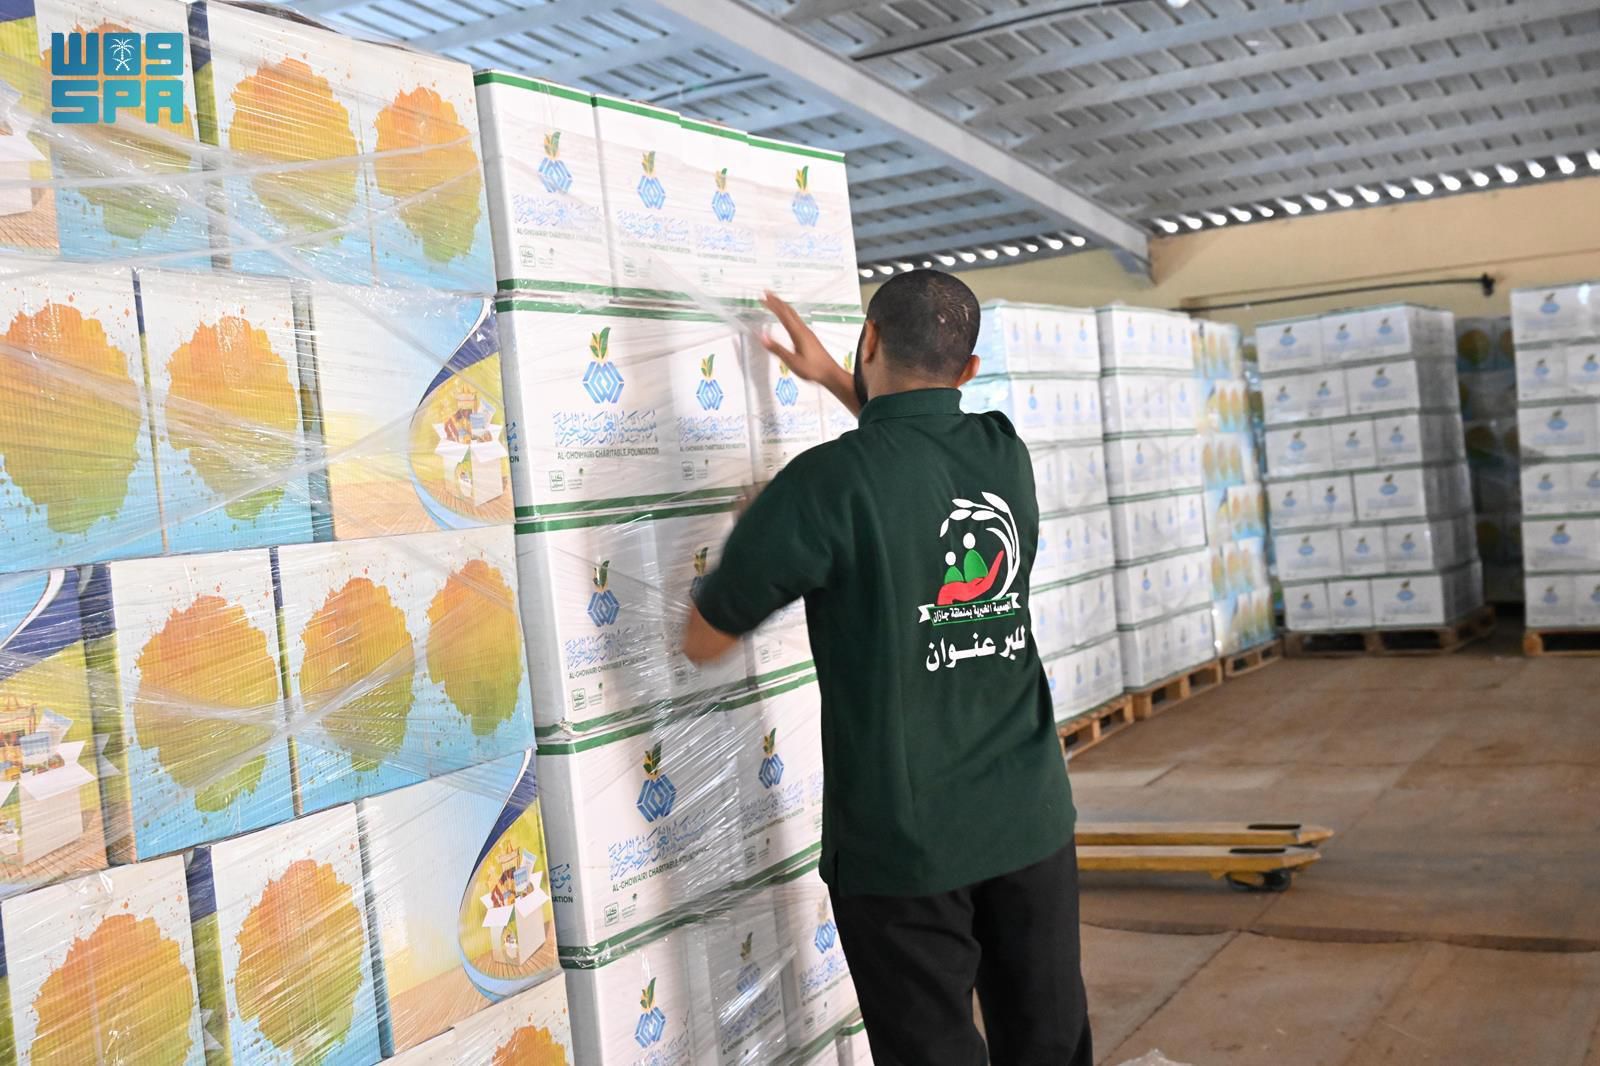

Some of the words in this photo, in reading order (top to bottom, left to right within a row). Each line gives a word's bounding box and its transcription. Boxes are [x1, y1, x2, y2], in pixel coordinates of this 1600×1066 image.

[932, 610, 950, 623] جازان
[949, 607, 973, 619] بمنطقة
[972, 603, 993, 618] الخيرية
[998, 624, 1026, 661] للبر
[925, 632, 997, 672] عنوان
